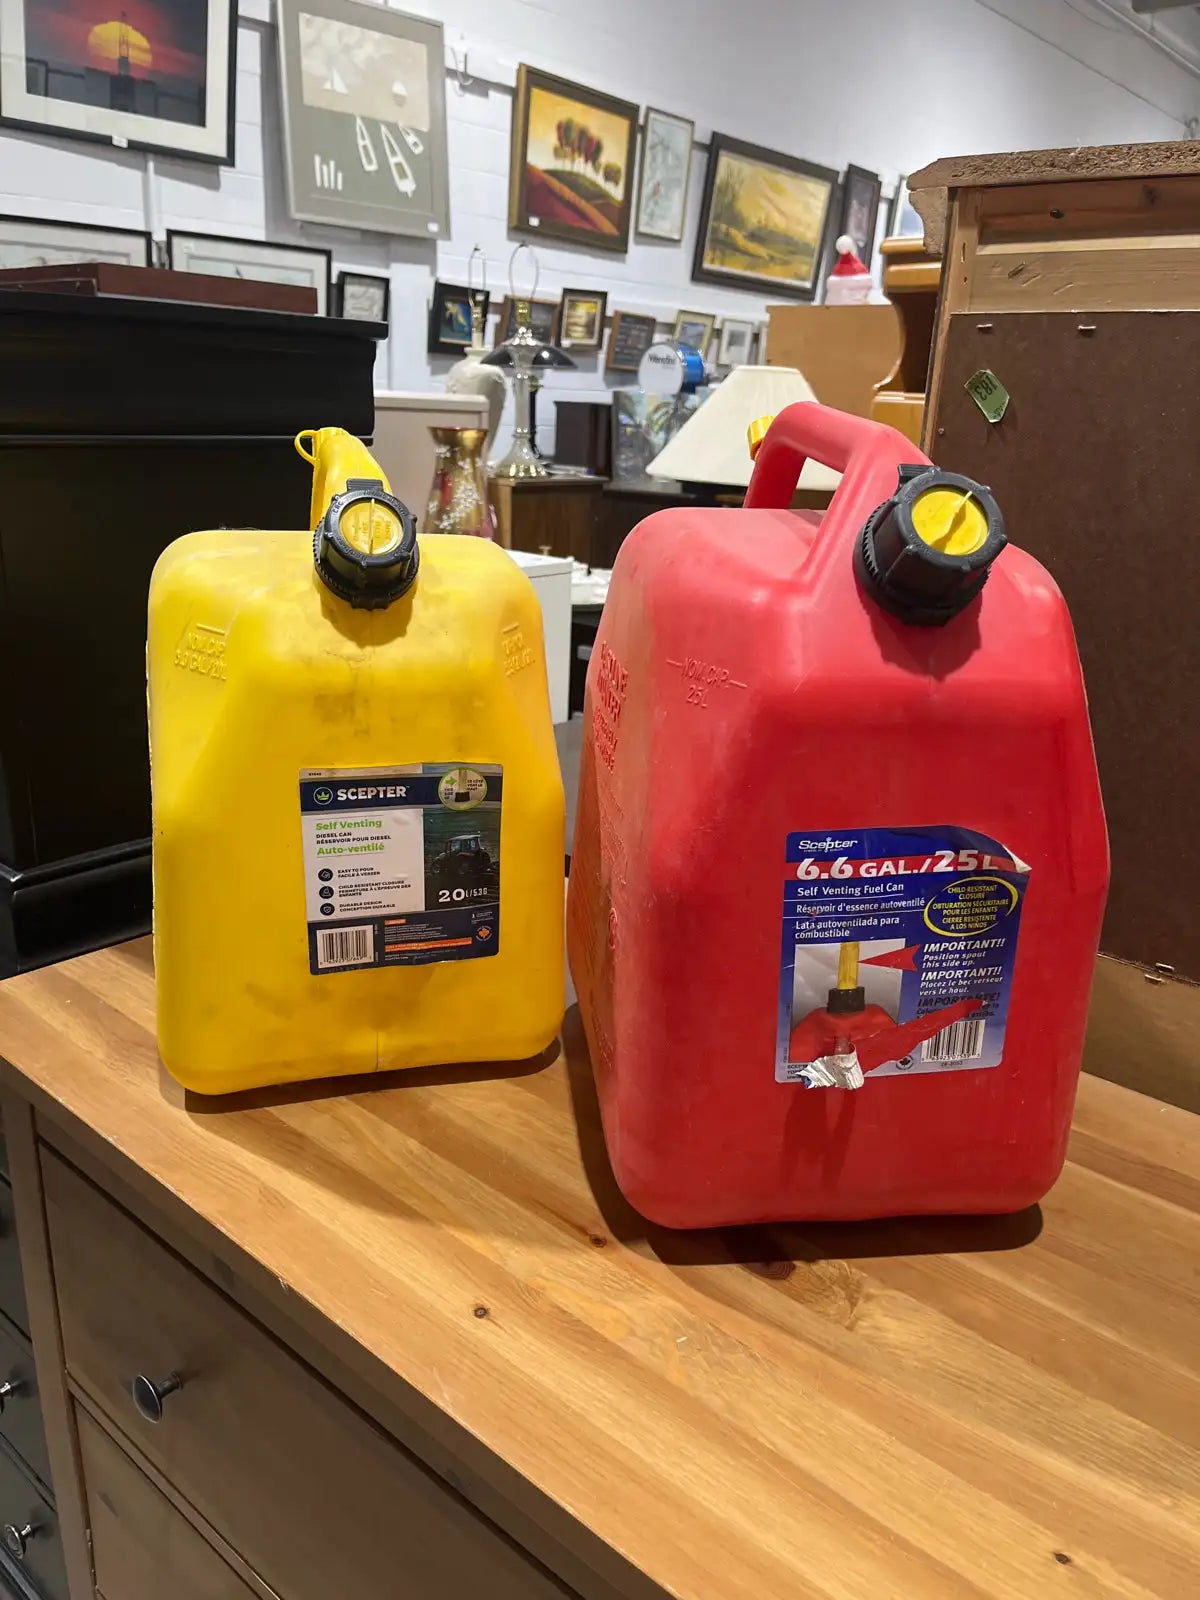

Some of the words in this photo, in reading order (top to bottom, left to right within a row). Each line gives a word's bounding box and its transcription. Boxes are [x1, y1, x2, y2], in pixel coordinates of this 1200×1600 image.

[337, 786, 407, 800] SCEPTER
[316, 821, 337, 830] Self
[340, 819, 382, 829] Venting
[317, 842, 385, 855] Auto-ventilé
[799, 837, 858, 852] Scepter
[797, 857, 853, 880] 6.6
[797, 887, 818, 896] Self
[822, 886, 861, 896] Venting
[864, 884, 883, 893] Fuel
[886, 883, 904, 891] Can
[797, 903, 835, 913] Réservoir
[838, 903, 878, 911] d'essence
[880, 898, 925, 909] autoventilé
[796, 921, 815, 930] Lata
[817, 917, 877, 929] autoventilada
[880, 917, 900, 926] para
[795, 929, 850, 939] combustible
[923, 938, 1006, 952] IMPORTANT!!
[923, 953, 959, 961] Position
[961, 951, 986, 959] spout
[921, 966, 1002, 981] IMPORTANT!!
